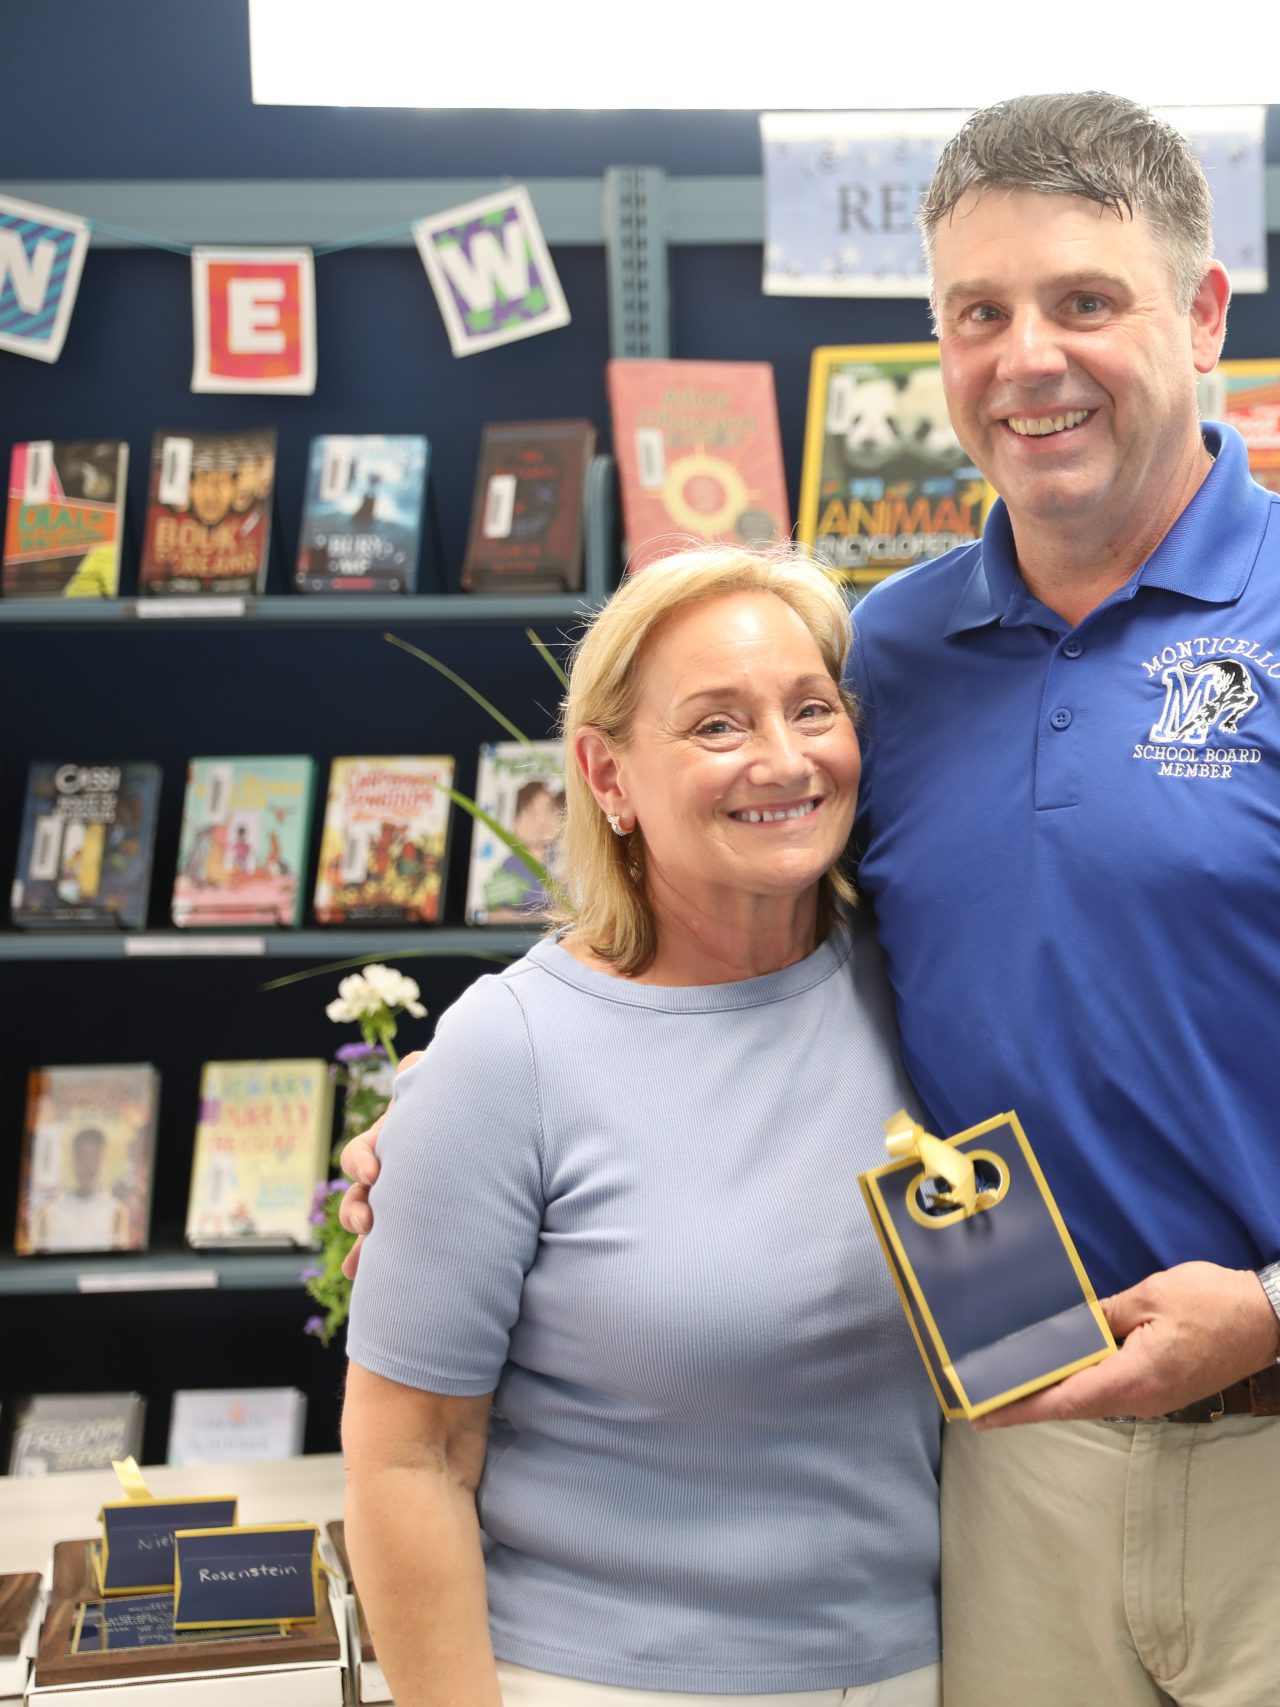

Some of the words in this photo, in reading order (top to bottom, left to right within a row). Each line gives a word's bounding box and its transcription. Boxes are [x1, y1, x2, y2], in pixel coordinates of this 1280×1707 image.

[836, 183, 931, 234] RE
[818, 496, 978, 536] ANIMAL
[1133, 744, 1200, 762] SCHOOL
[1203, 748, 1261, 763] BOARD
[1158, 762, 1233, 779] MEMBER
[198, 1564, 298, 1584] Rosenstein
